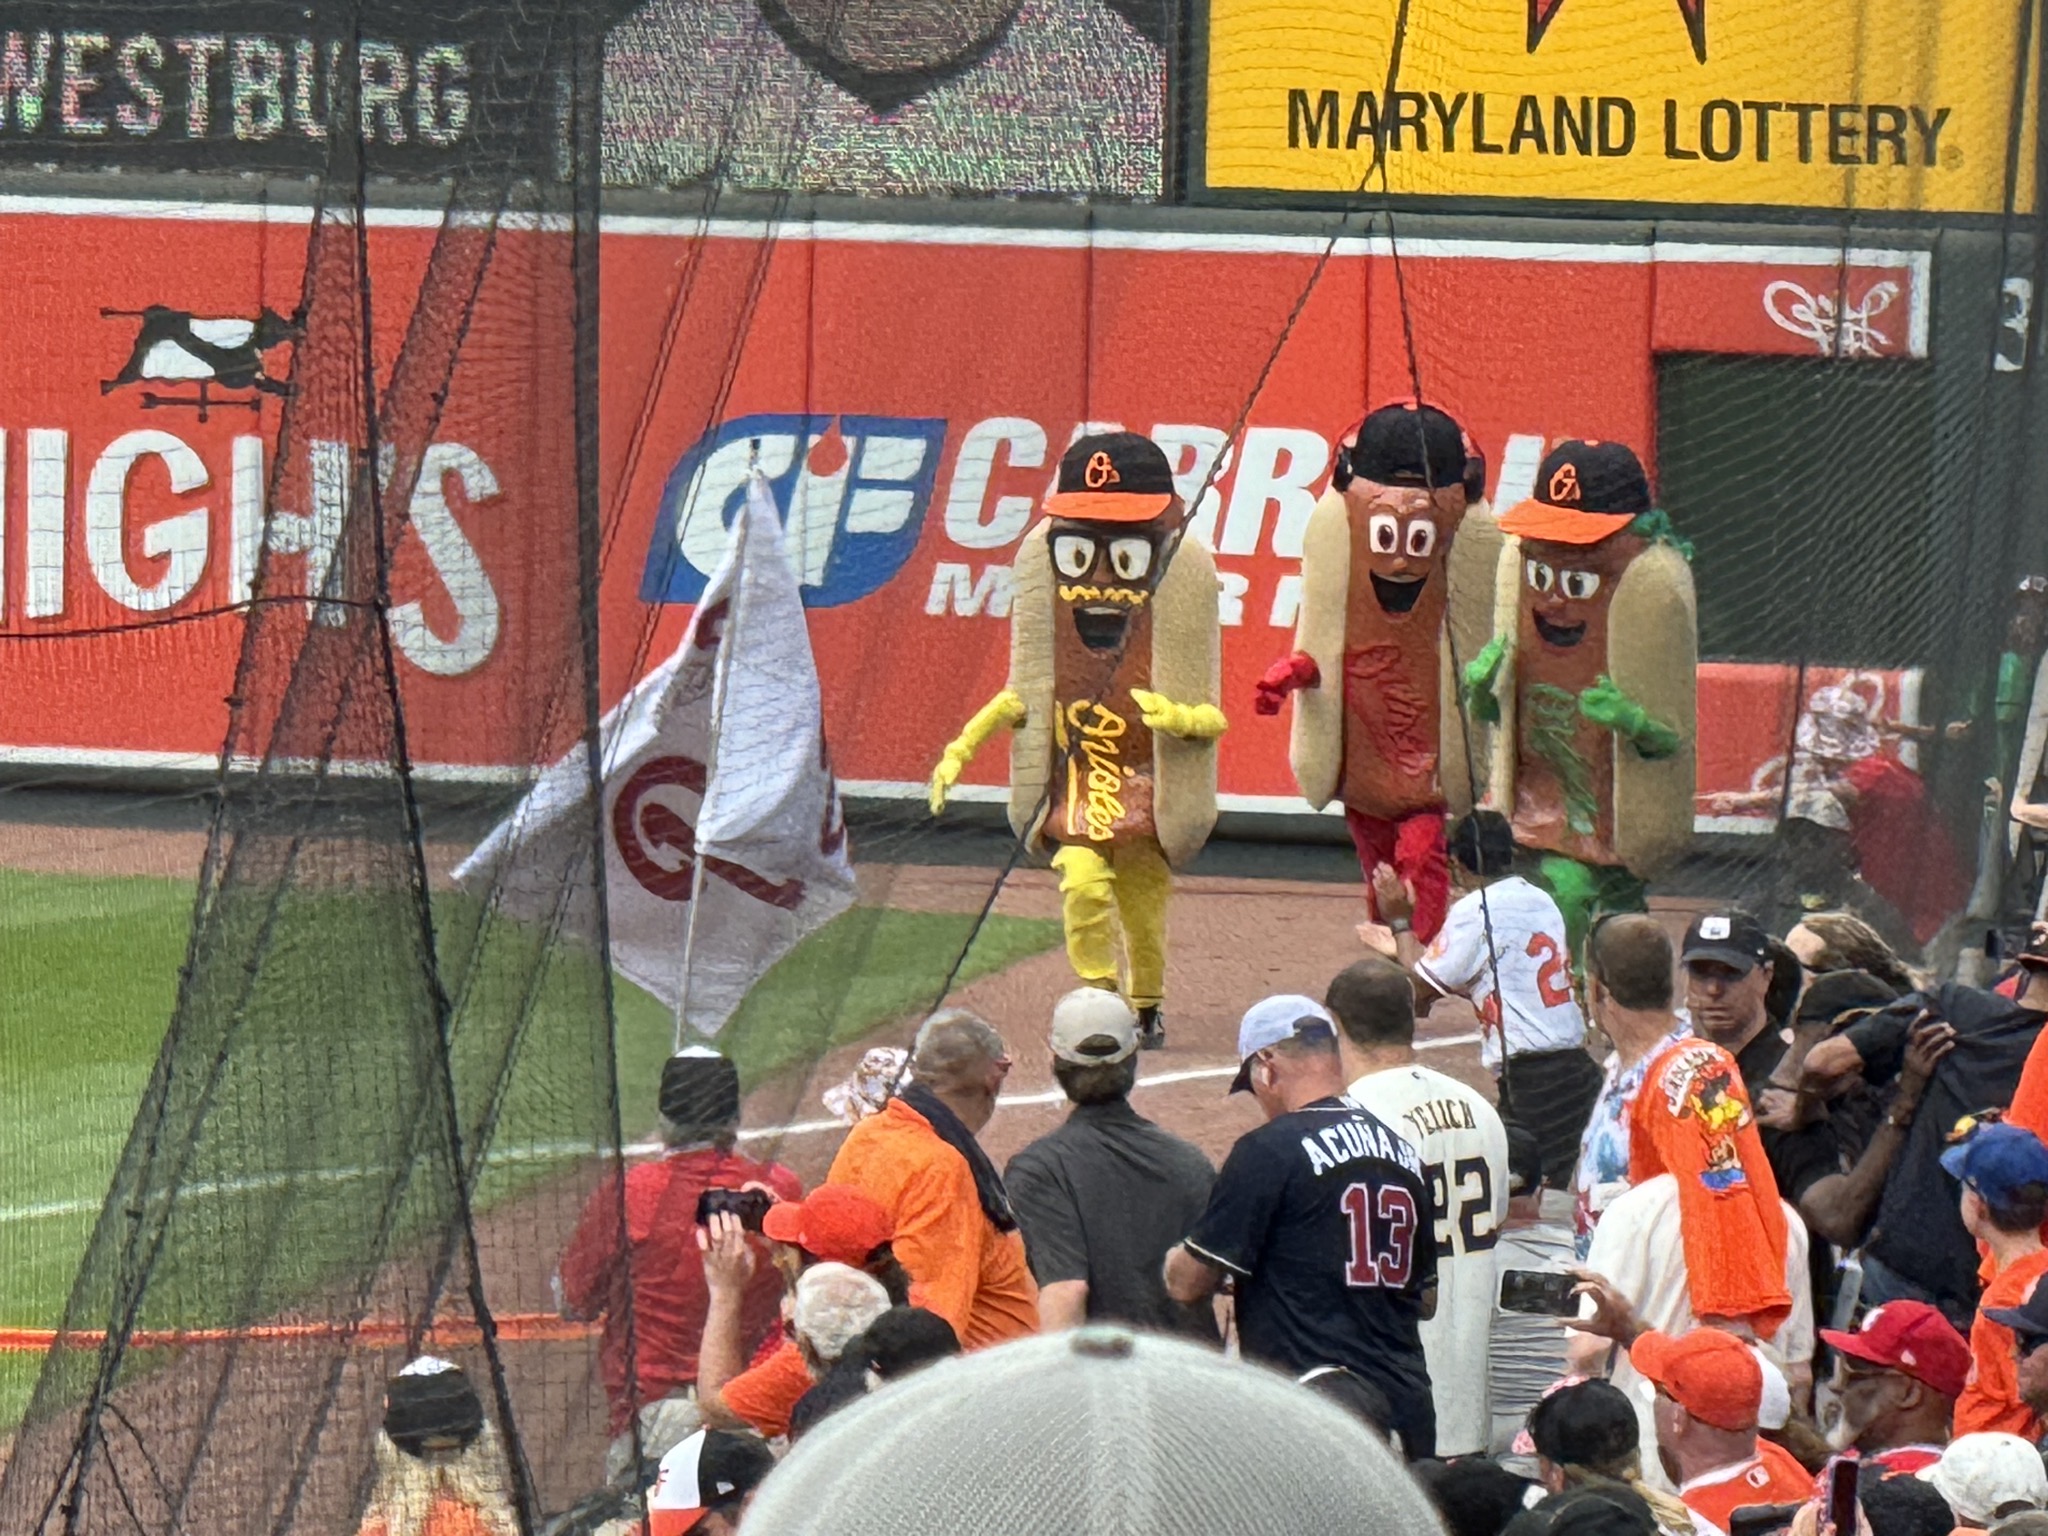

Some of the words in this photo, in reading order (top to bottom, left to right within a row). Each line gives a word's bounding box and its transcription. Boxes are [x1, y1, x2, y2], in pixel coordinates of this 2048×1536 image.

[1288, 88, 1635, 158] MARYLAND
[1664, 98, 1950, 167] LOTTERY
[1301, 1114, 1396, 1176] ACUÑA
[1402, 1098, 1477, 1139] YELICH
[1340, 1182, 1419, 1289] 13
[1424, 1156, 1498, 1257] 22
